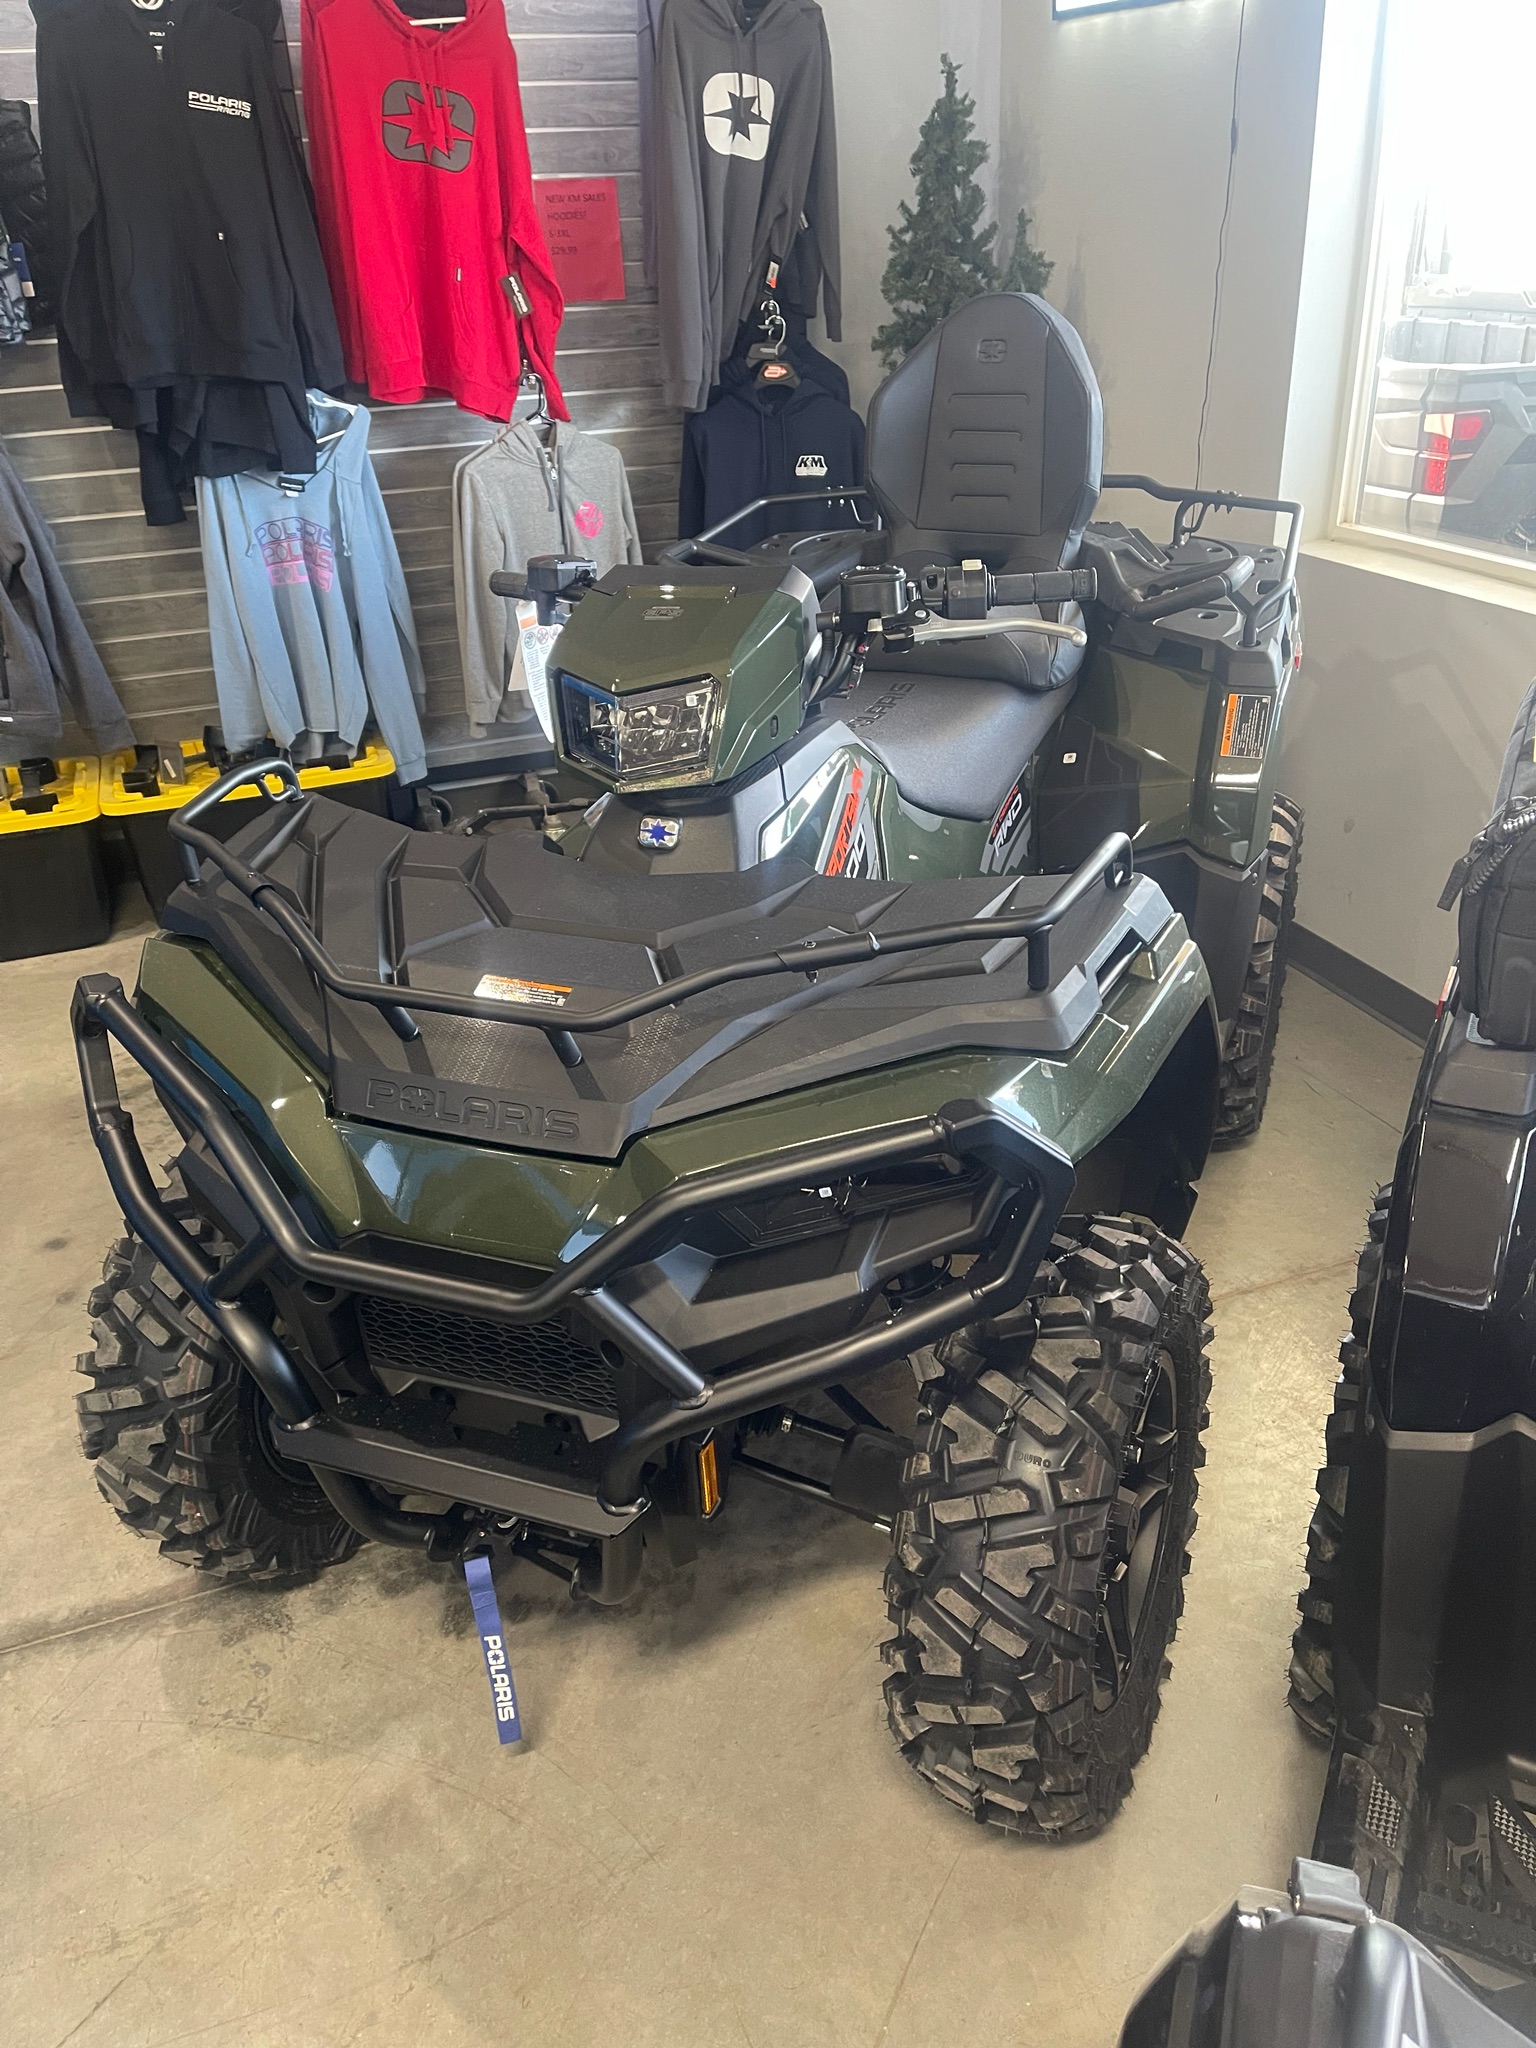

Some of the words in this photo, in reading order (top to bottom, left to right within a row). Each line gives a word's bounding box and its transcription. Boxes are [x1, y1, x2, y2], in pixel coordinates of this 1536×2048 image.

[188, 91, 251, 112] POLARIS
[216, 105, 251, 119] RACING
[366, 1078, 580, 1141] POLARIS
[1014, 1451, 1051, 1468] DURO
[484, 1635, 515, 1722] POLARIS
